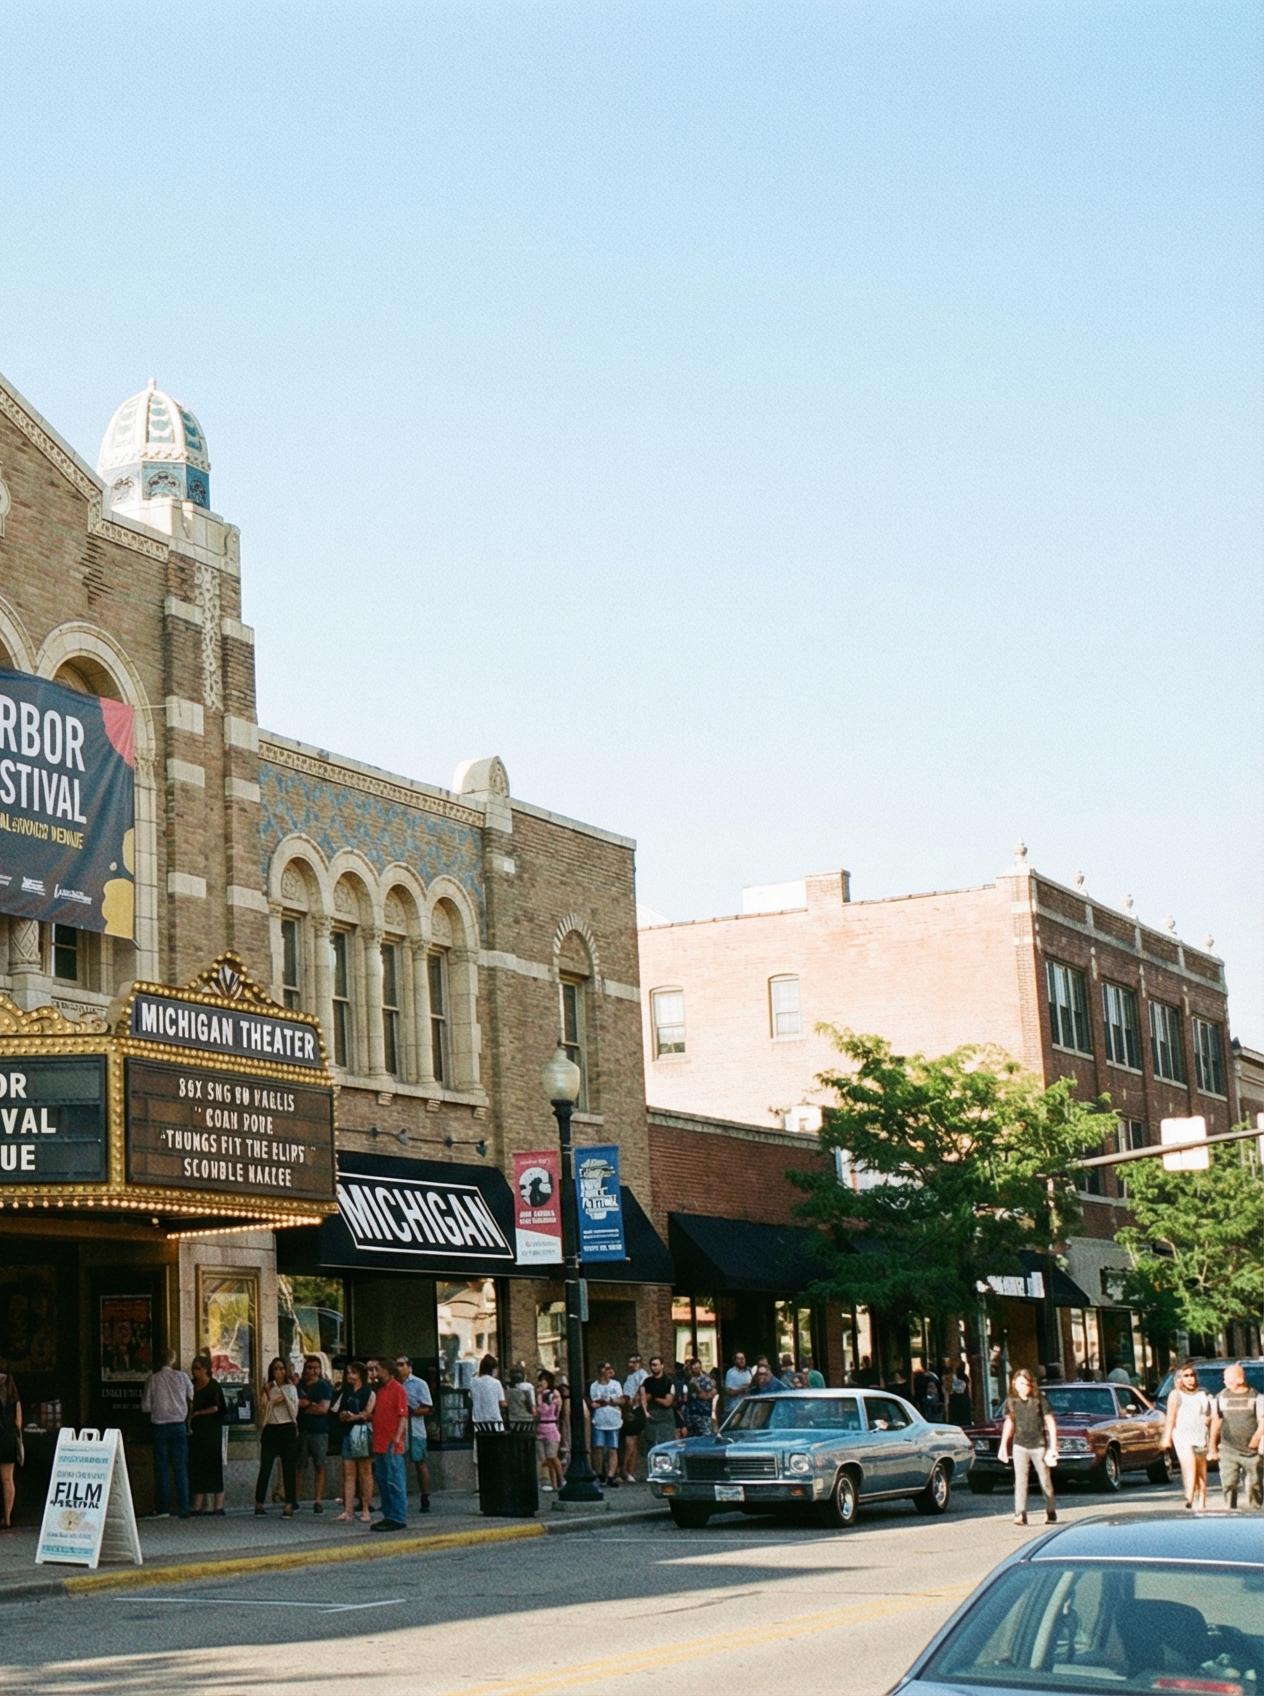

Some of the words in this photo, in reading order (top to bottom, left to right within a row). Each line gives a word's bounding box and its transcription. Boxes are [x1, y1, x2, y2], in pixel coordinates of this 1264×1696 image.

[141, 1002, 233, 1046] MICHIGAN
[240, 1020, 314, 1060] THEATER
[221, 1136, 242, 1156] FIT
[336, 1184, 506, 1248] MICHIGAN
[55, 1482, 103, 1503] FILM
